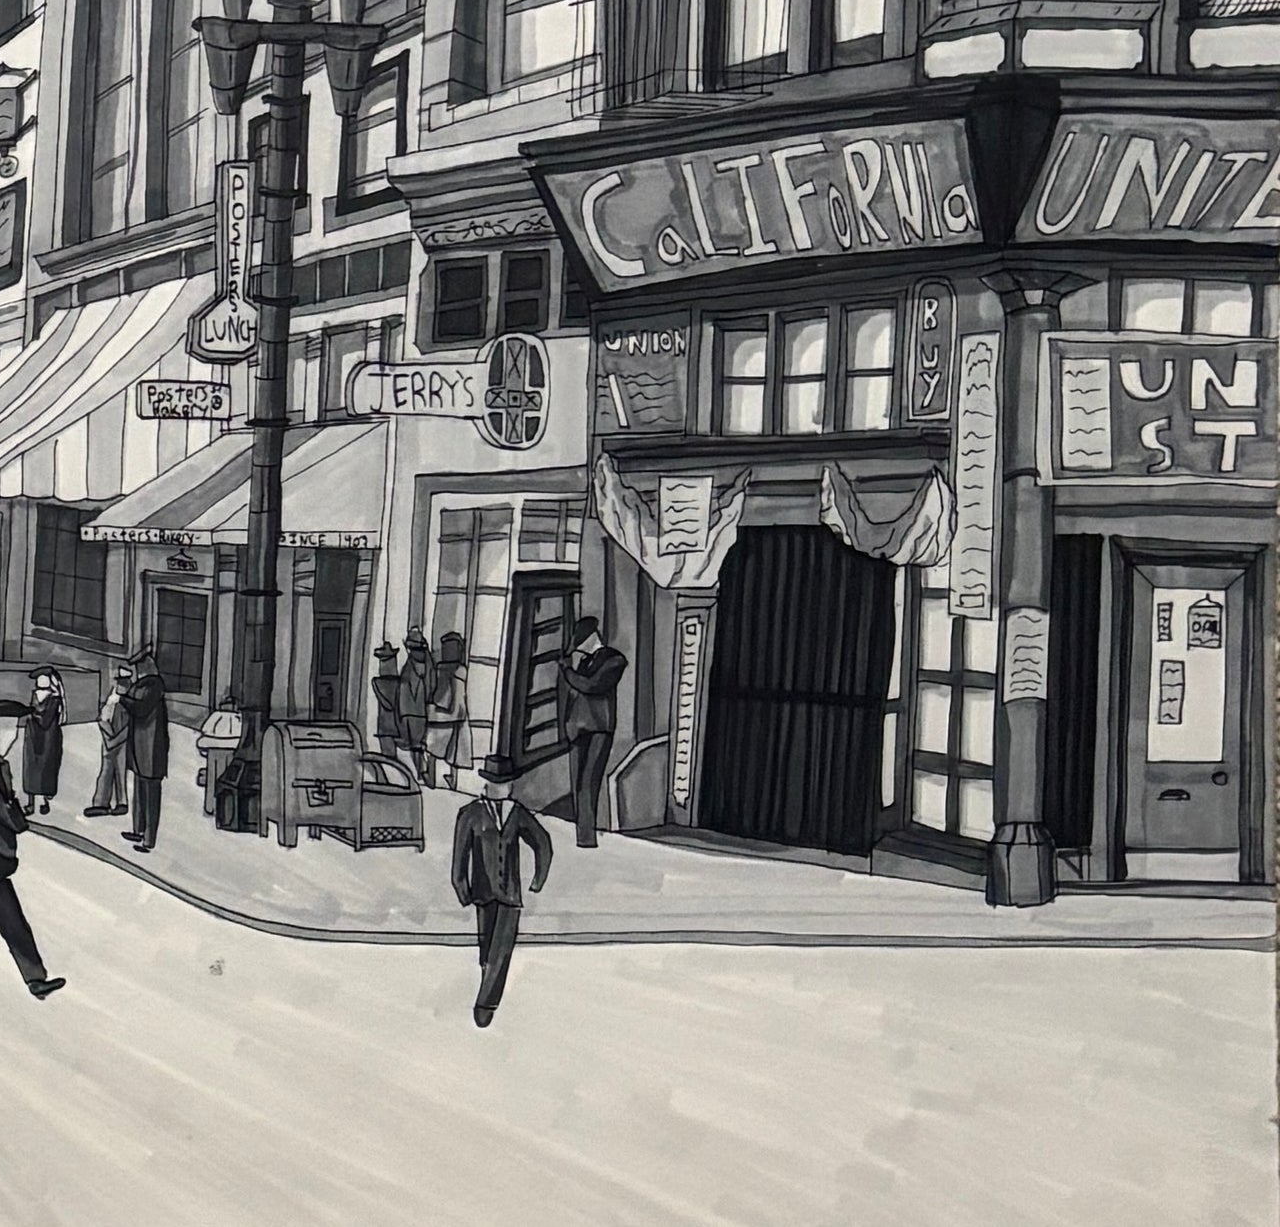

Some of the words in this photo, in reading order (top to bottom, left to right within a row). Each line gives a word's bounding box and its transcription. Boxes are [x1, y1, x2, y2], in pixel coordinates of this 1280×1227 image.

[204, 315, 257, 344] LUNCH
[604, 330, 686, 357] UNION
[918, 297, 943, 406] BUY
[368, 367, 476, 412] JERRY'S
